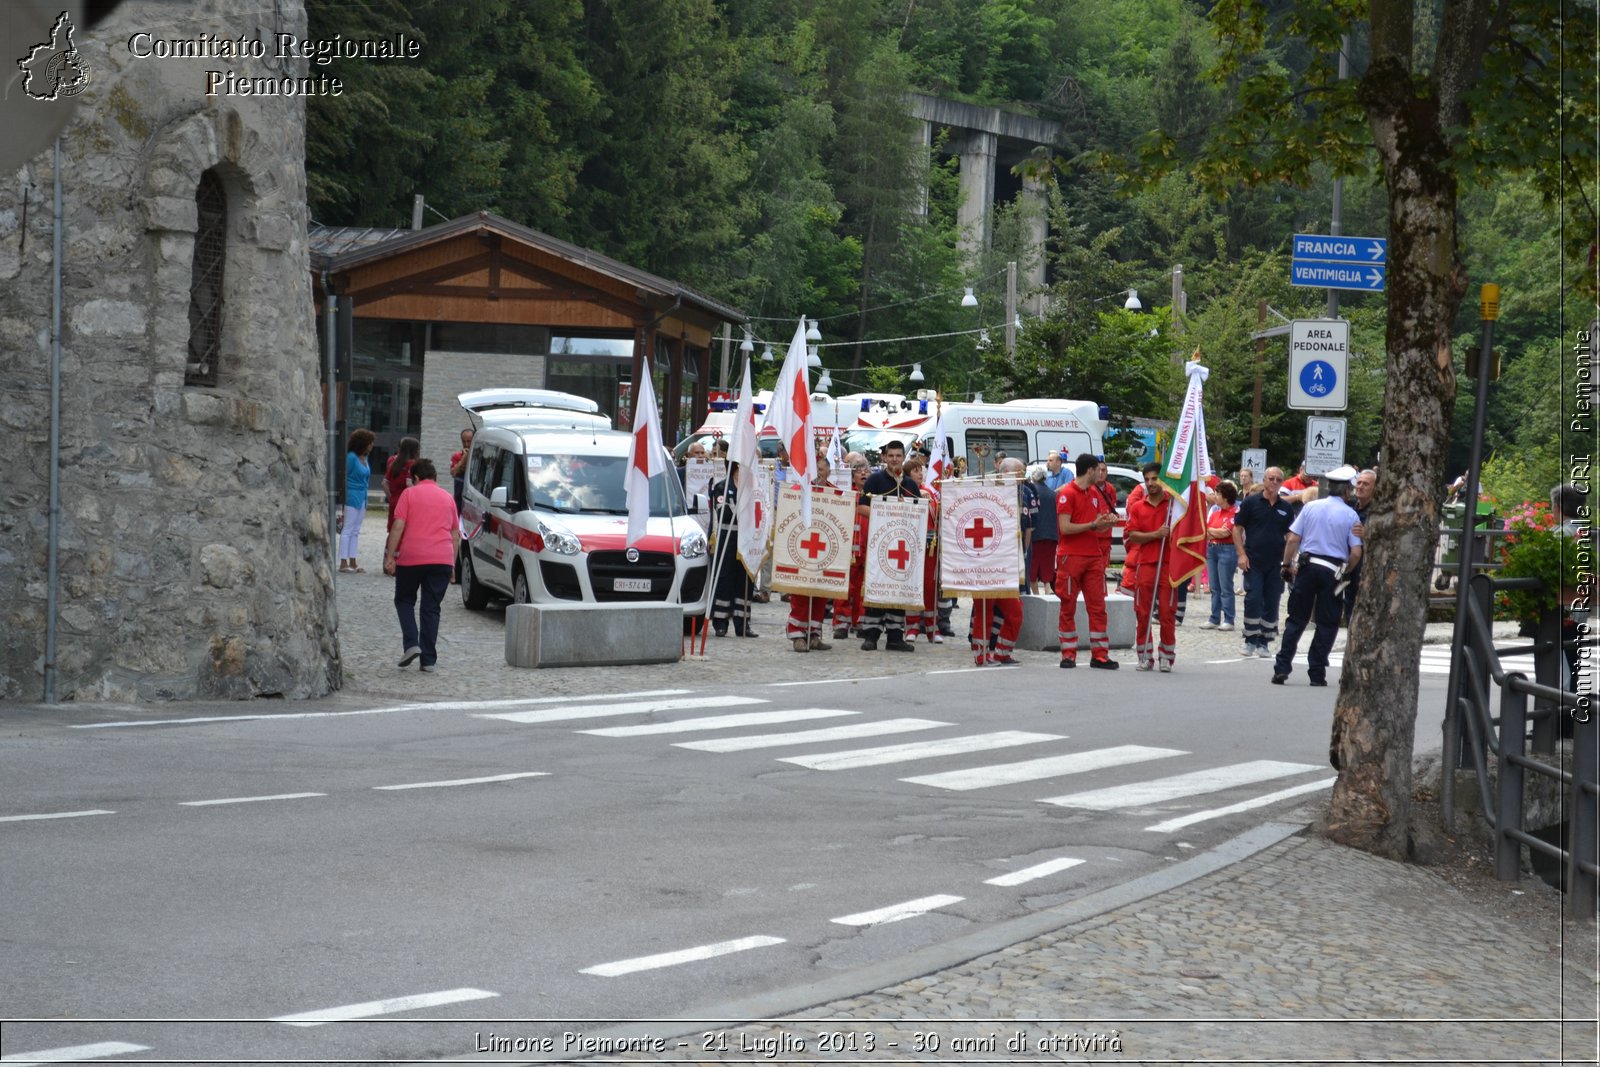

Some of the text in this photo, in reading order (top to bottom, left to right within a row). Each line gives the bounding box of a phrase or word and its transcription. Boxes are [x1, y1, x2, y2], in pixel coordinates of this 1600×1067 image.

[1297, 241, 1356, 256] FRANCIA
[1295, 267, 1362, 283] VENTIMIGLIA
[1307, 330, 1333, 339] AREA
[1293, 342, 1345, 352] PEDONALE
[962, 417, 1079, 428] CROCE ROSSA ITALIANA LIMONE P.TE
[944, 492, 1015, 520] CROCE ROSSA ITALIANA
[778, 512, 798, 534] CROCE
[825, 511, 850, 543] ITALIANA
[870, 525, 887, 549] CROCE
[886, 519, 908, 529] ROSSA
[775, 573, 808, 582] COMITATO
[870, 582, 899, 591] COMITATO
